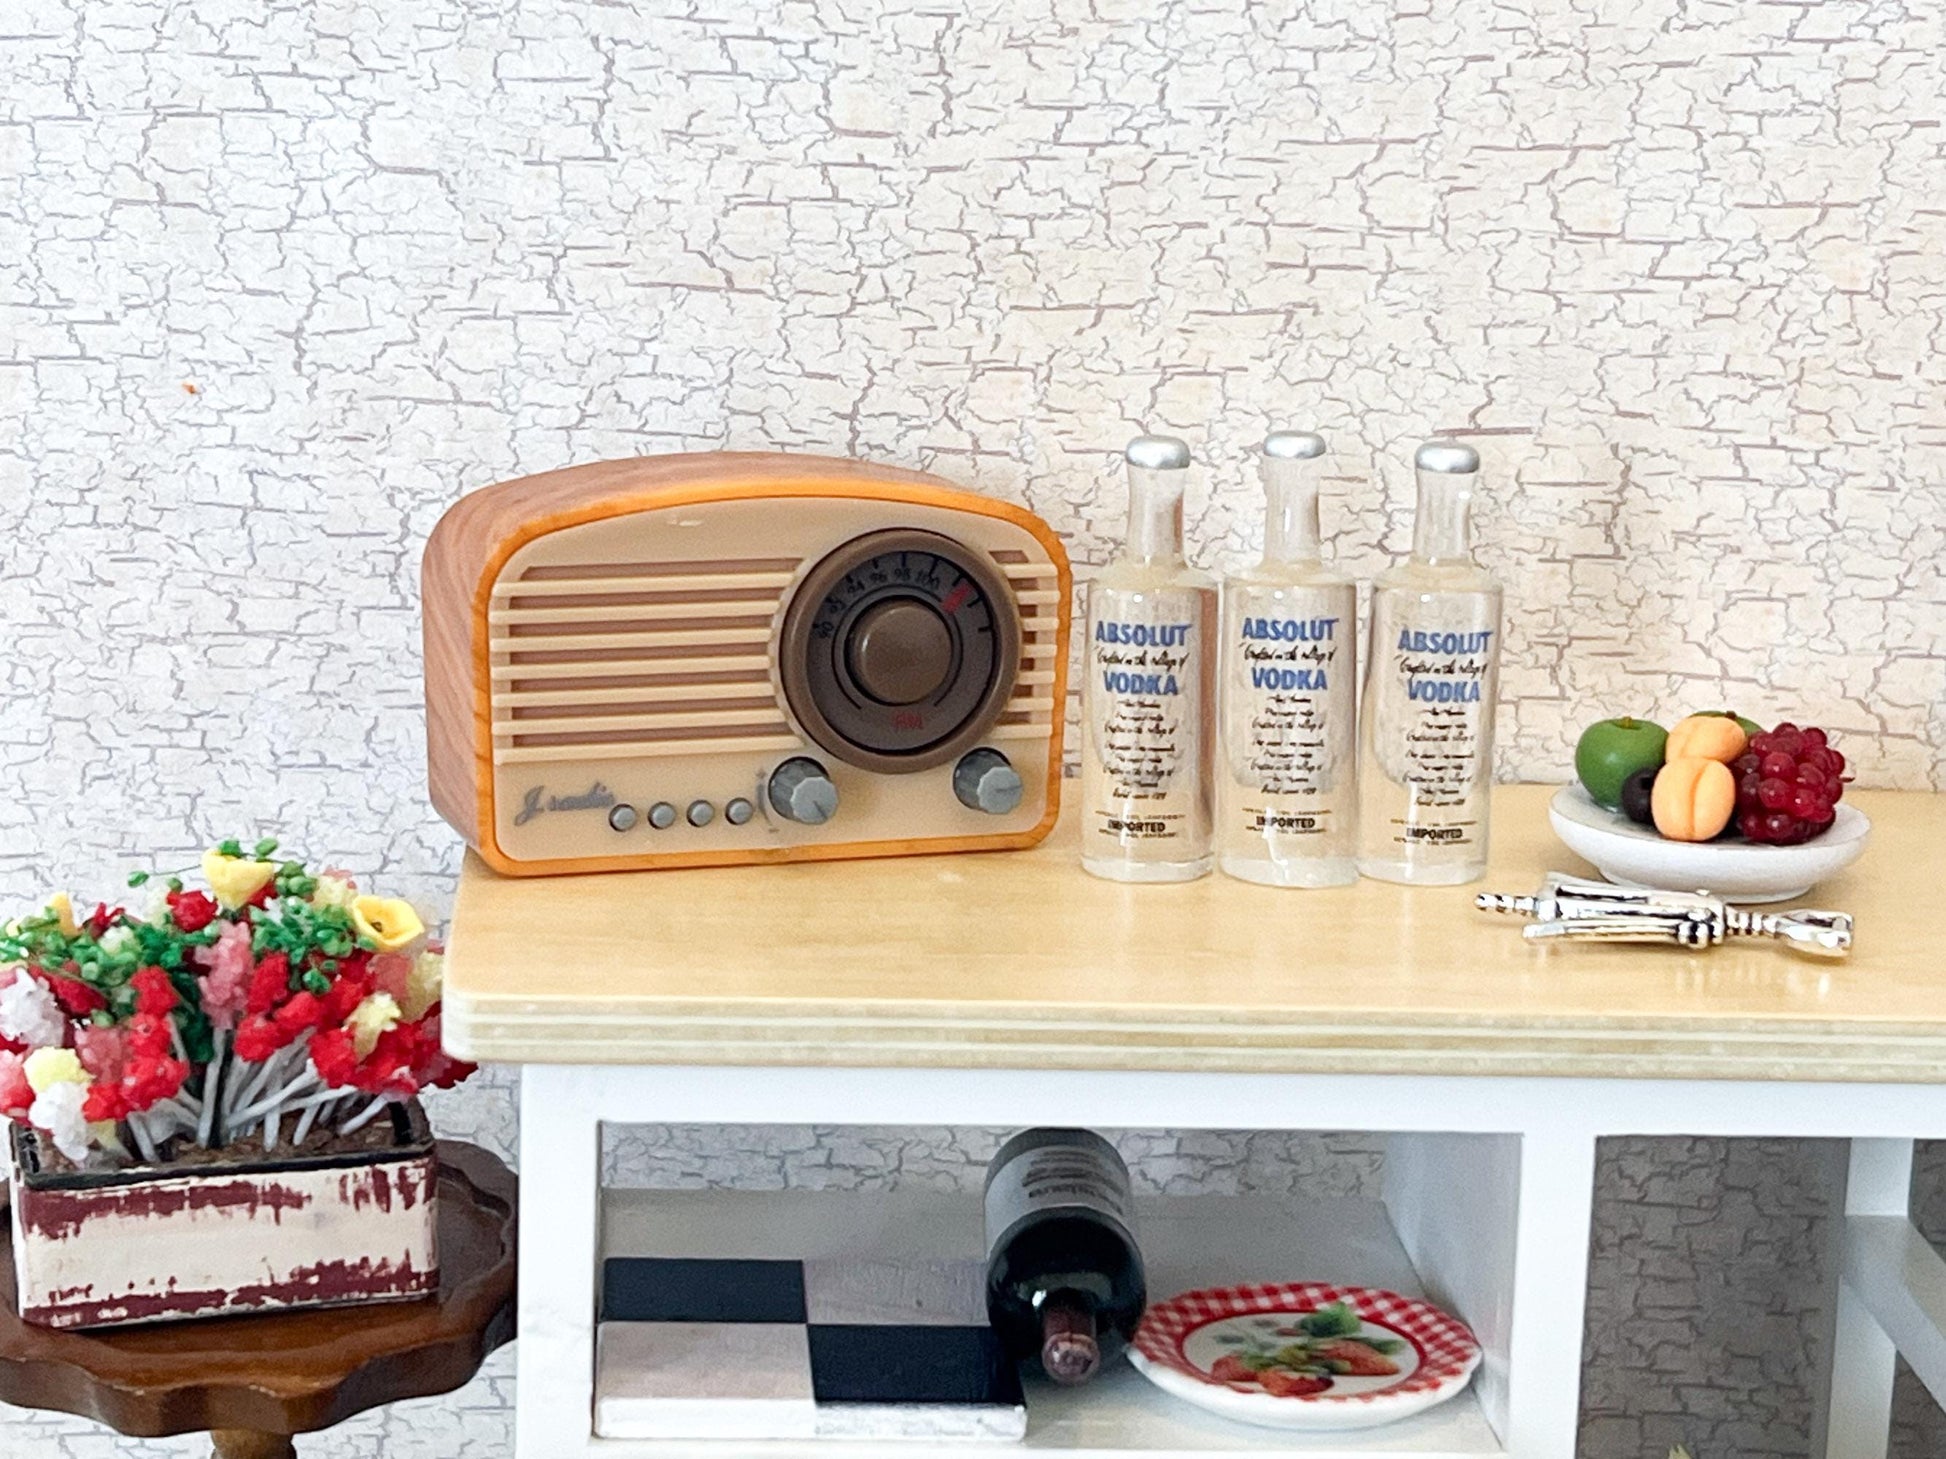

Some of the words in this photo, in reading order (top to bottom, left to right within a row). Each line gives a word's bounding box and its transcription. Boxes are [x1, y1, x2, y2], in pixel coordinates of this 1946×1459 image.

[1096, 620, 1193, 647] ABSOLUT
[1242, 617, 1339, 642] ABSOLUT
[1397, 628, 1493, 655] ABSOLUT
[1103, 670, 1179, 695] VODKA
[1251, 667, 1327, 690] VODKA
[1407, 678, 1480, 703] VODKA
